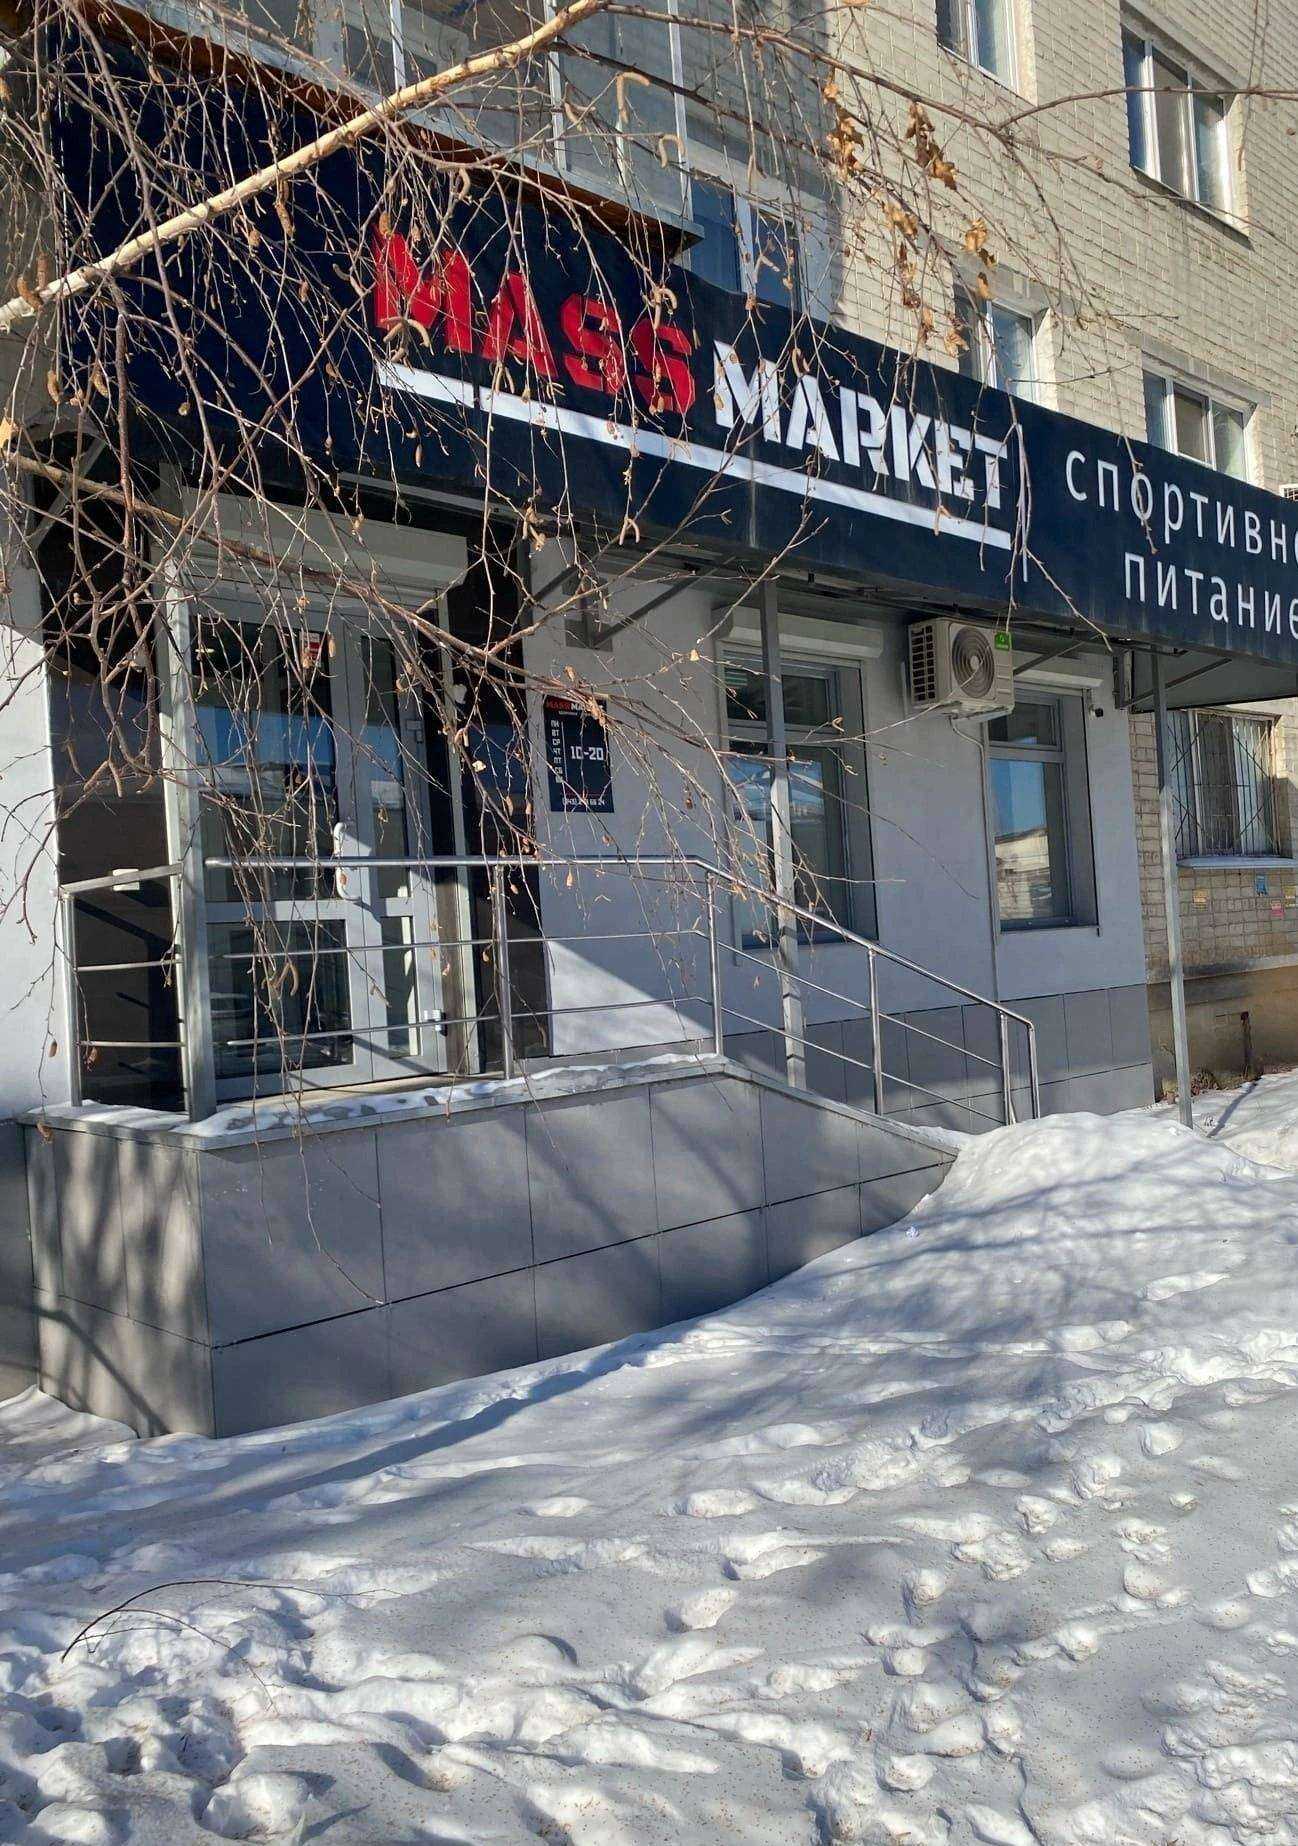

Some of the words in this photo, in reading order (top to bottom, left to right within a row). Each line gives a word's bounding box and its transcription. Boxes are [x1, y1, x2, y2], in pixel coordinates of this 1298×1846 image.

[371, 222, 696, 415] MASS
[713, 339, 1009, 509] MARKET
[1065, 449, 1298, 566] спортивн
[570, 745, 604, 761] 10-20
